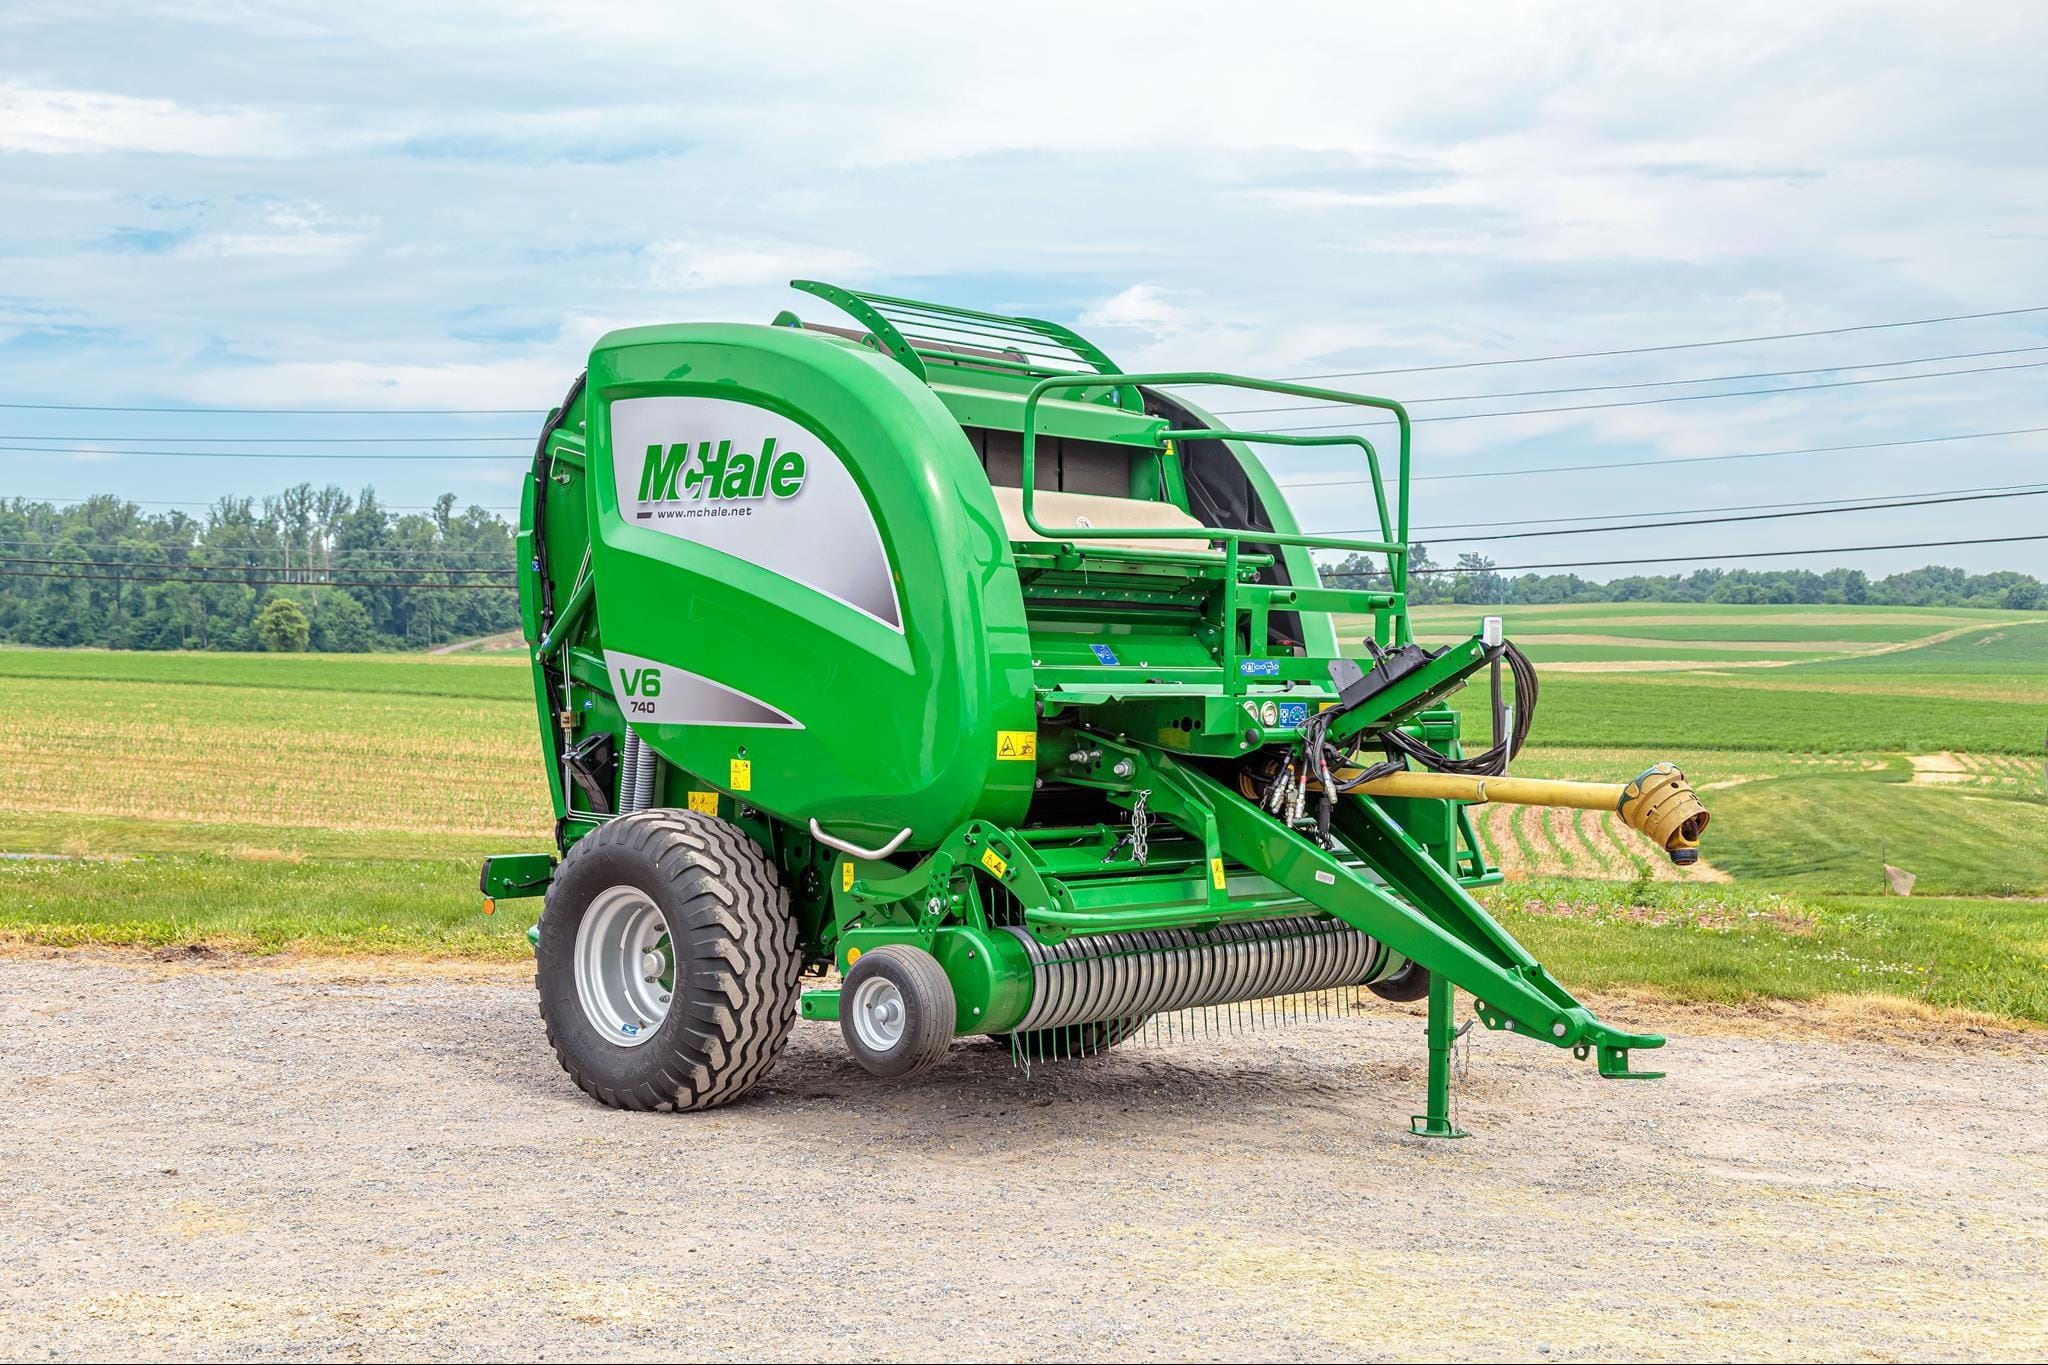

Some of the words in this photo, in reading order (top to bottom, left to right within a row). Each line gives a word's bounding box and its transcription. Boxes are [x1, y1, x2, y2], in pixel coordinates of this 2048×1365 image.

[637, 437, 806, 500] McHale
[657, 507, 752, 519] www.mchale.net
[619, 668, 661, 697] V6
[630, 701, 655, 713] 740
